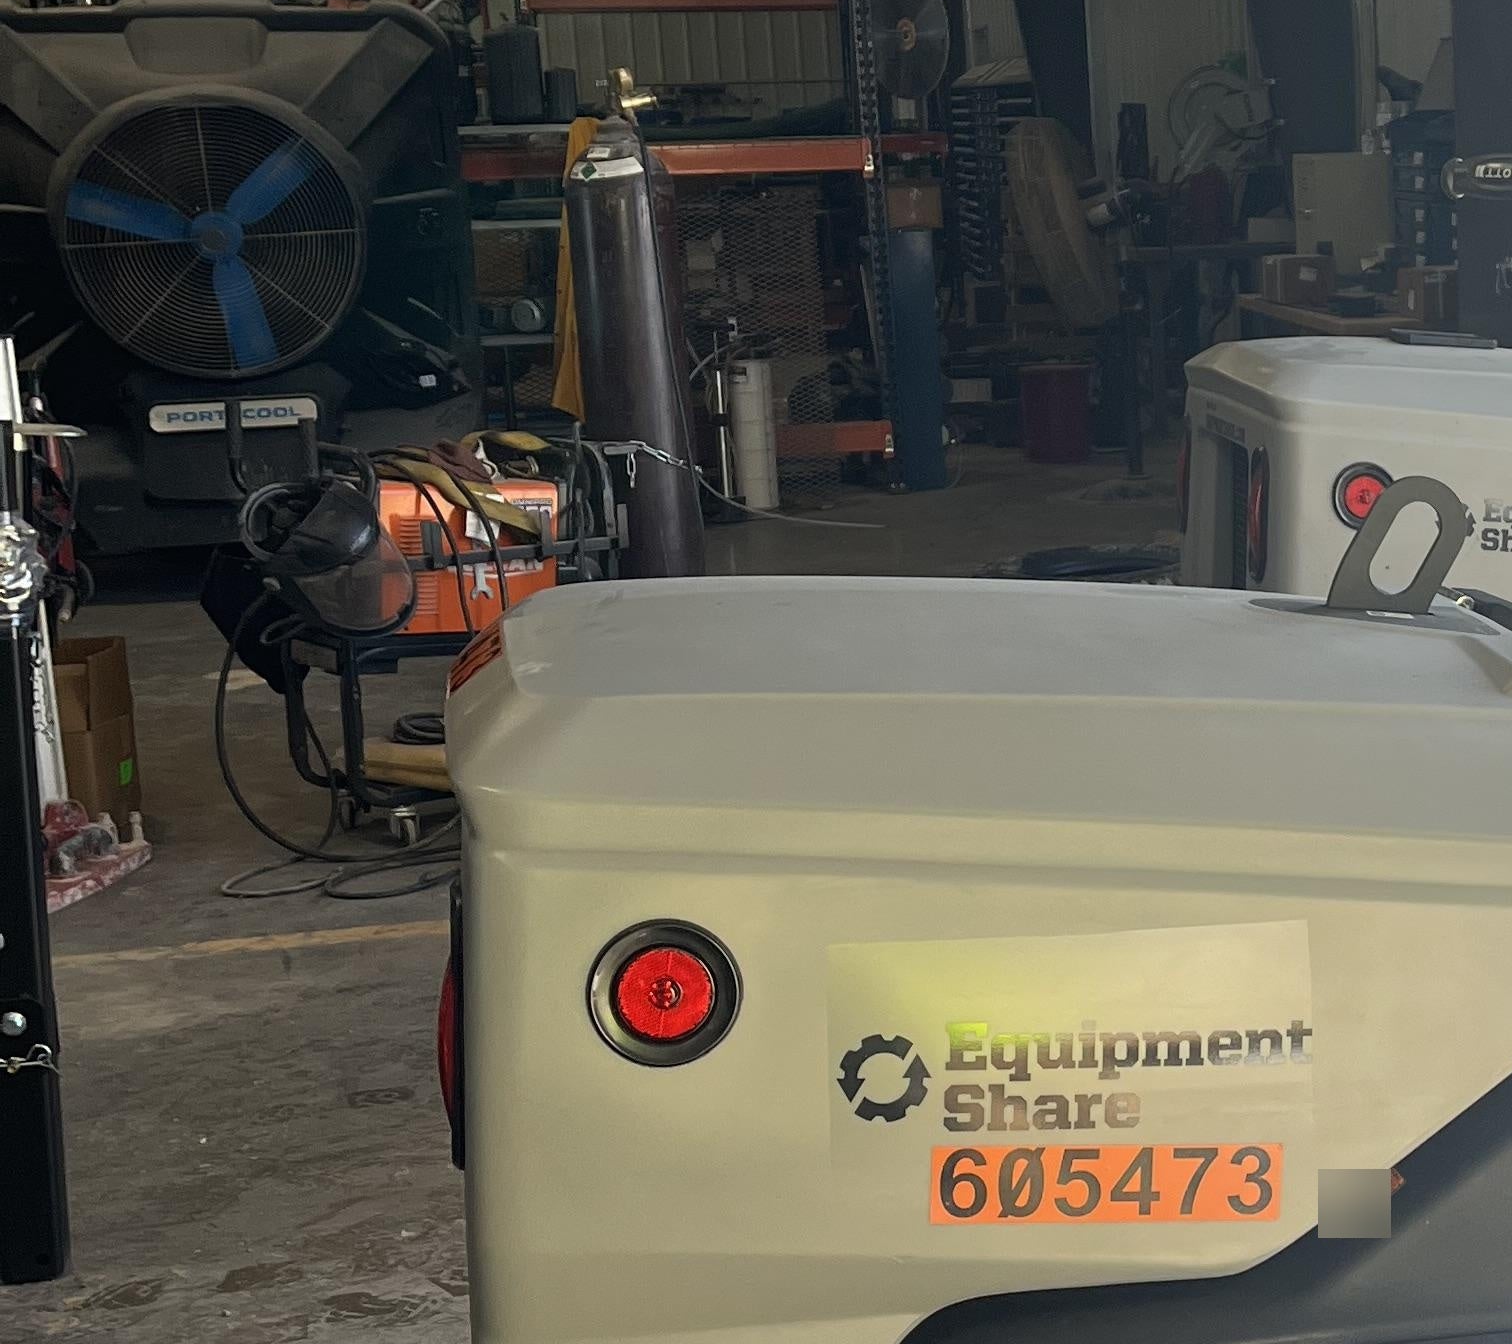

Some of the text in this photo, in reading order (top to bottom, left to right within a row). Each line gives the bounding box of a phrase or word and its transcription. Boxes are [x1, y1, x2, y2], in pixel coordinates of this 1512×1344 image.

[166, 406, 301, 424] PORTCOOL
[944, 1019, 1313, 1082] Equipment
[942, 1084, 1142, 1133] Share
[939, 1146, 1274, 1219] 605473
